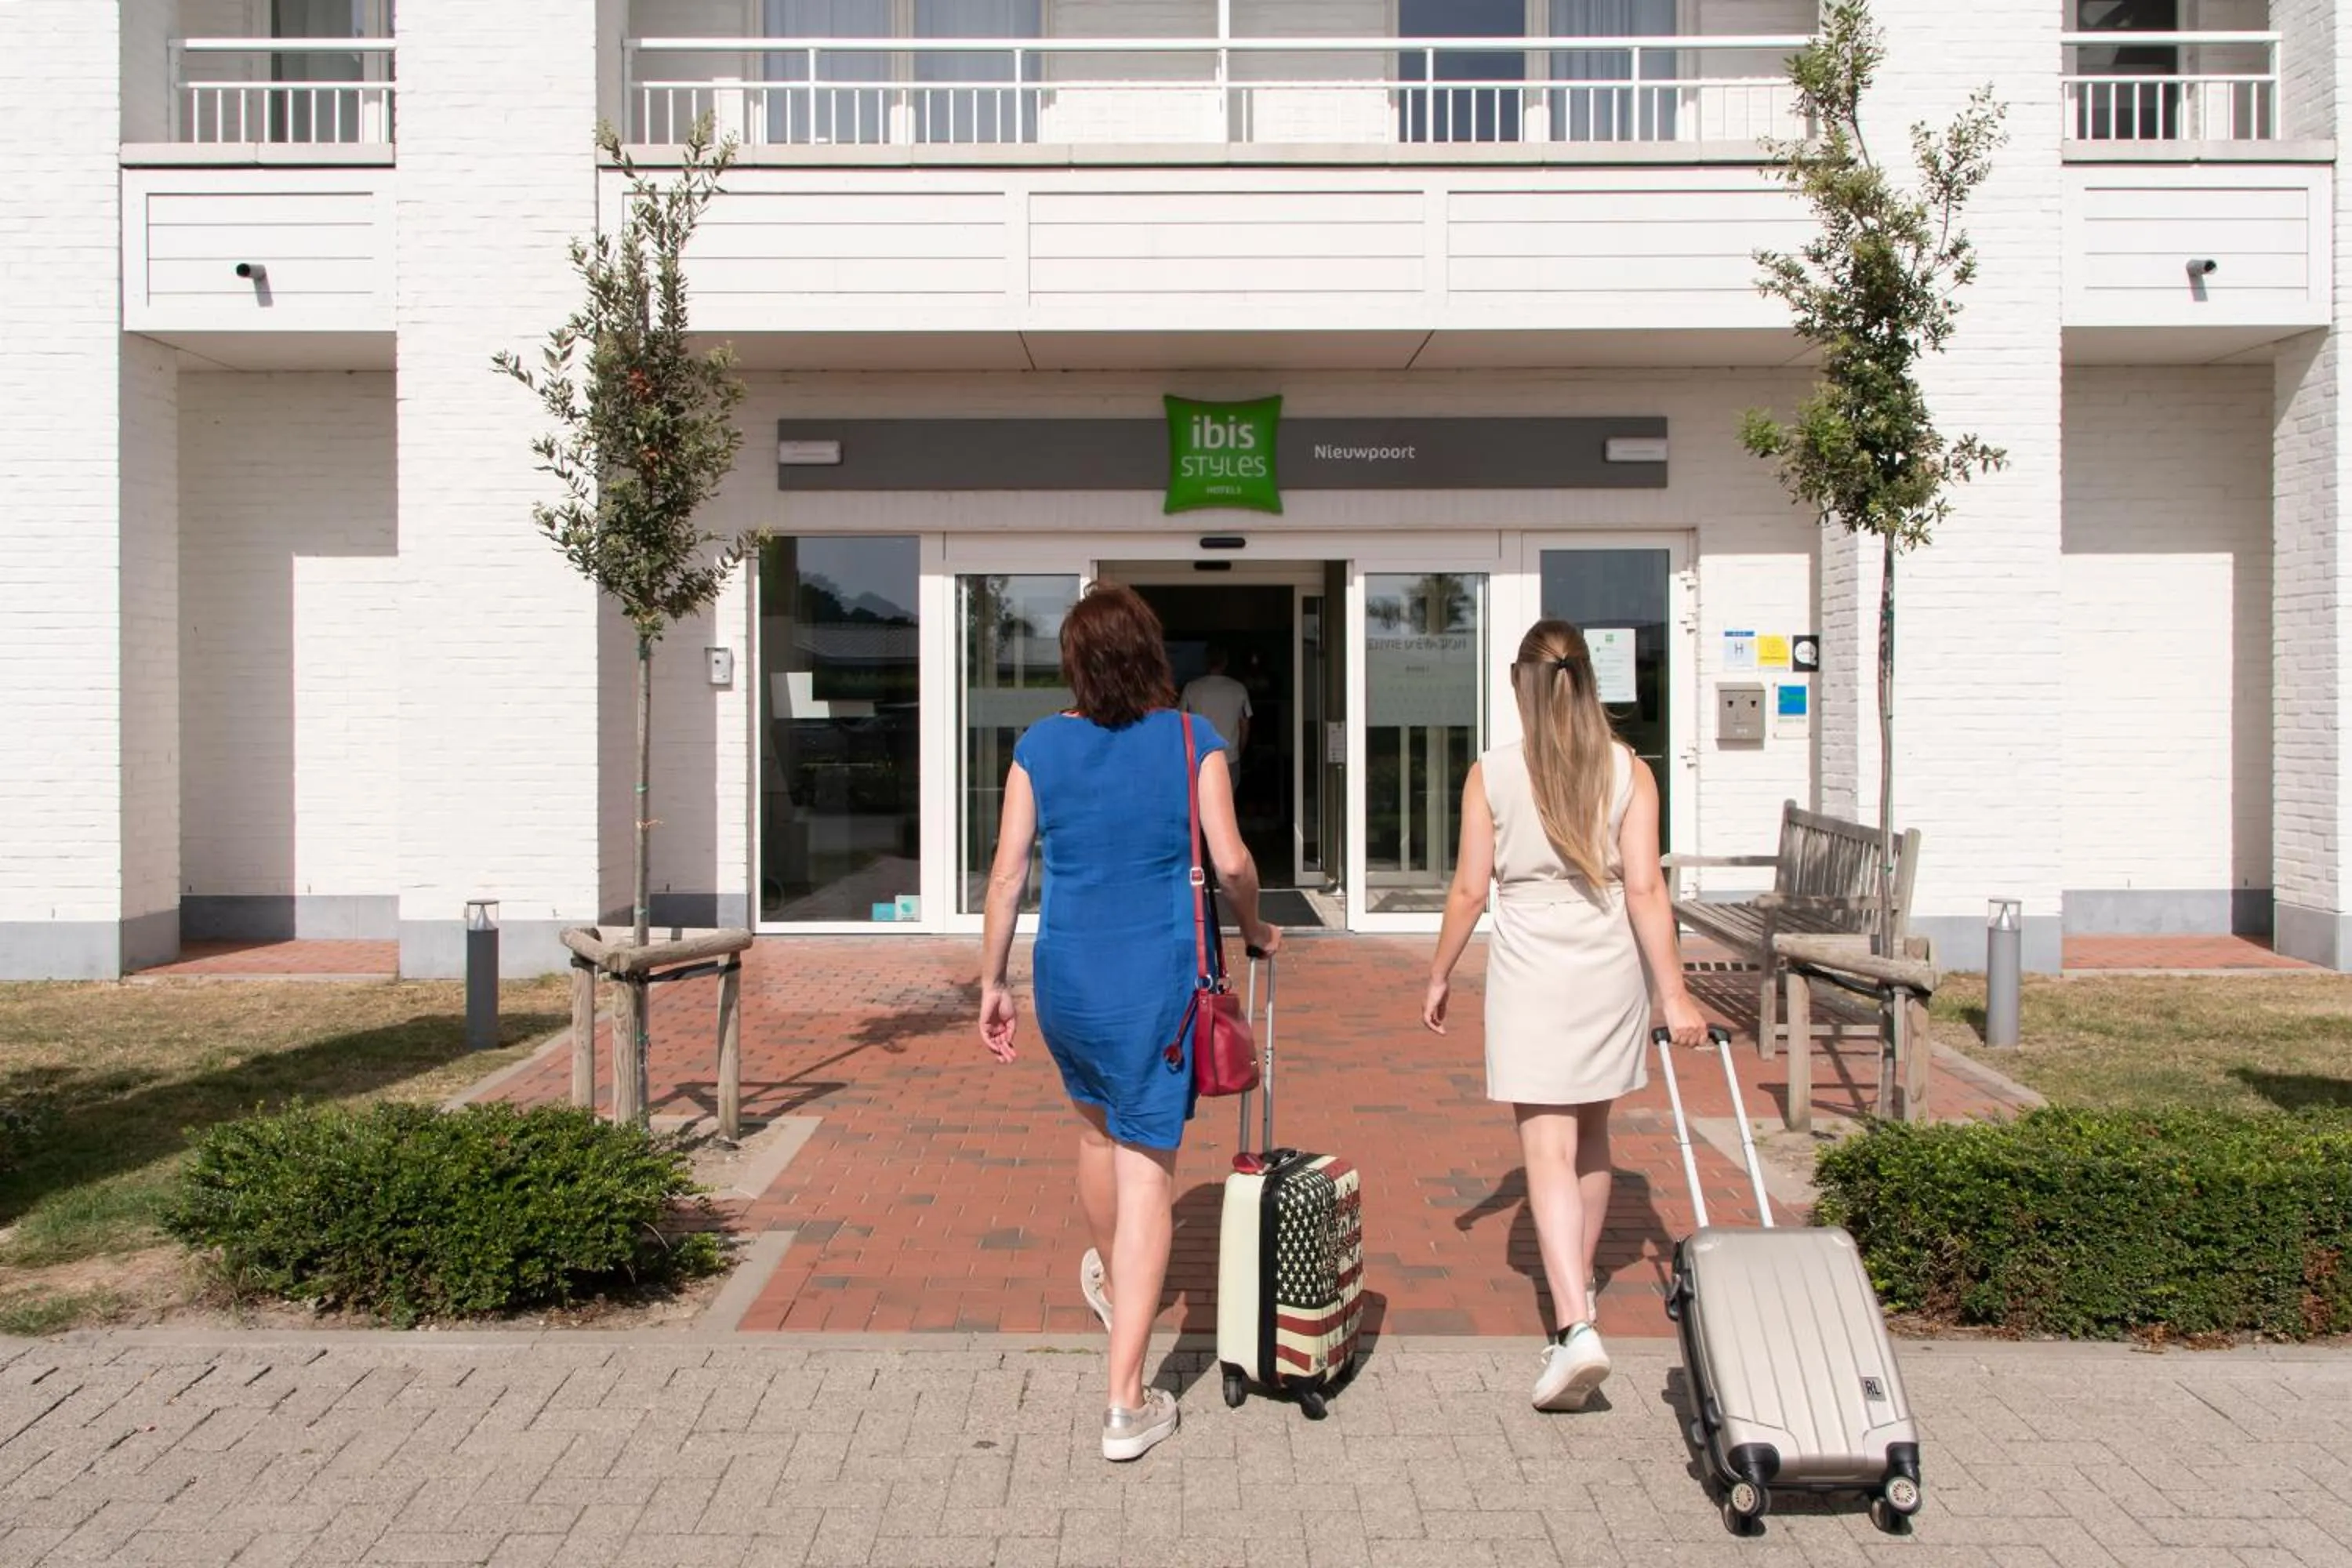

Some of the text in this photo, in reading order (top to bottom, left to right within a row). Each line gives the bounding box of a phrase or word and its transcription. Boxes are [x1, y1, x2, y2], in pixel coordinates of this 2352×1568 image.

[1192, 415, 1255, 449] ibis
[1314, 445, 1416, 462] Nieuwpoort
[1865, 1380, 1882, 1396] RL
